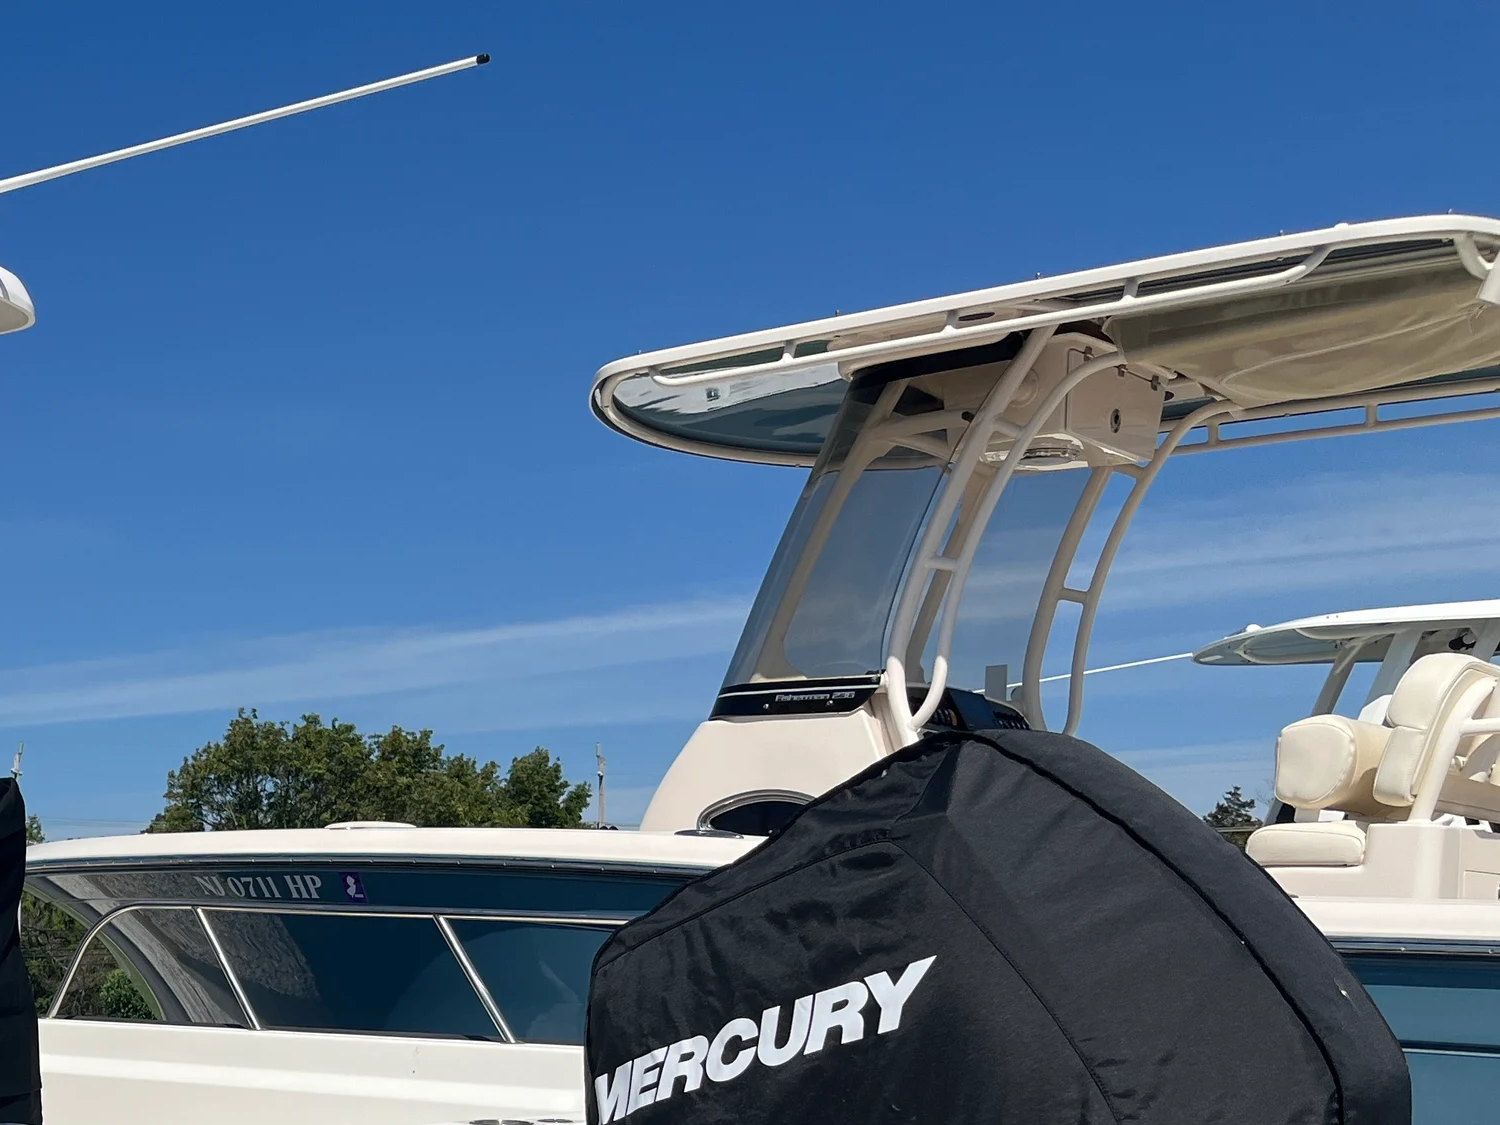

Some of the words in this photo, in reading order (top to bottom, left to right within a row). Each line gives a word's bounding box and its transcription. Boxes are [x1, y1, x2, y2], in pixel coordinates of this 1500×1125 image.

[774, 693, 830, 702] Fisherman
[192, 876, 226, 897] NJ
[226, 876, 281, 898] 0711
[283, 875, 323, 899] HP
